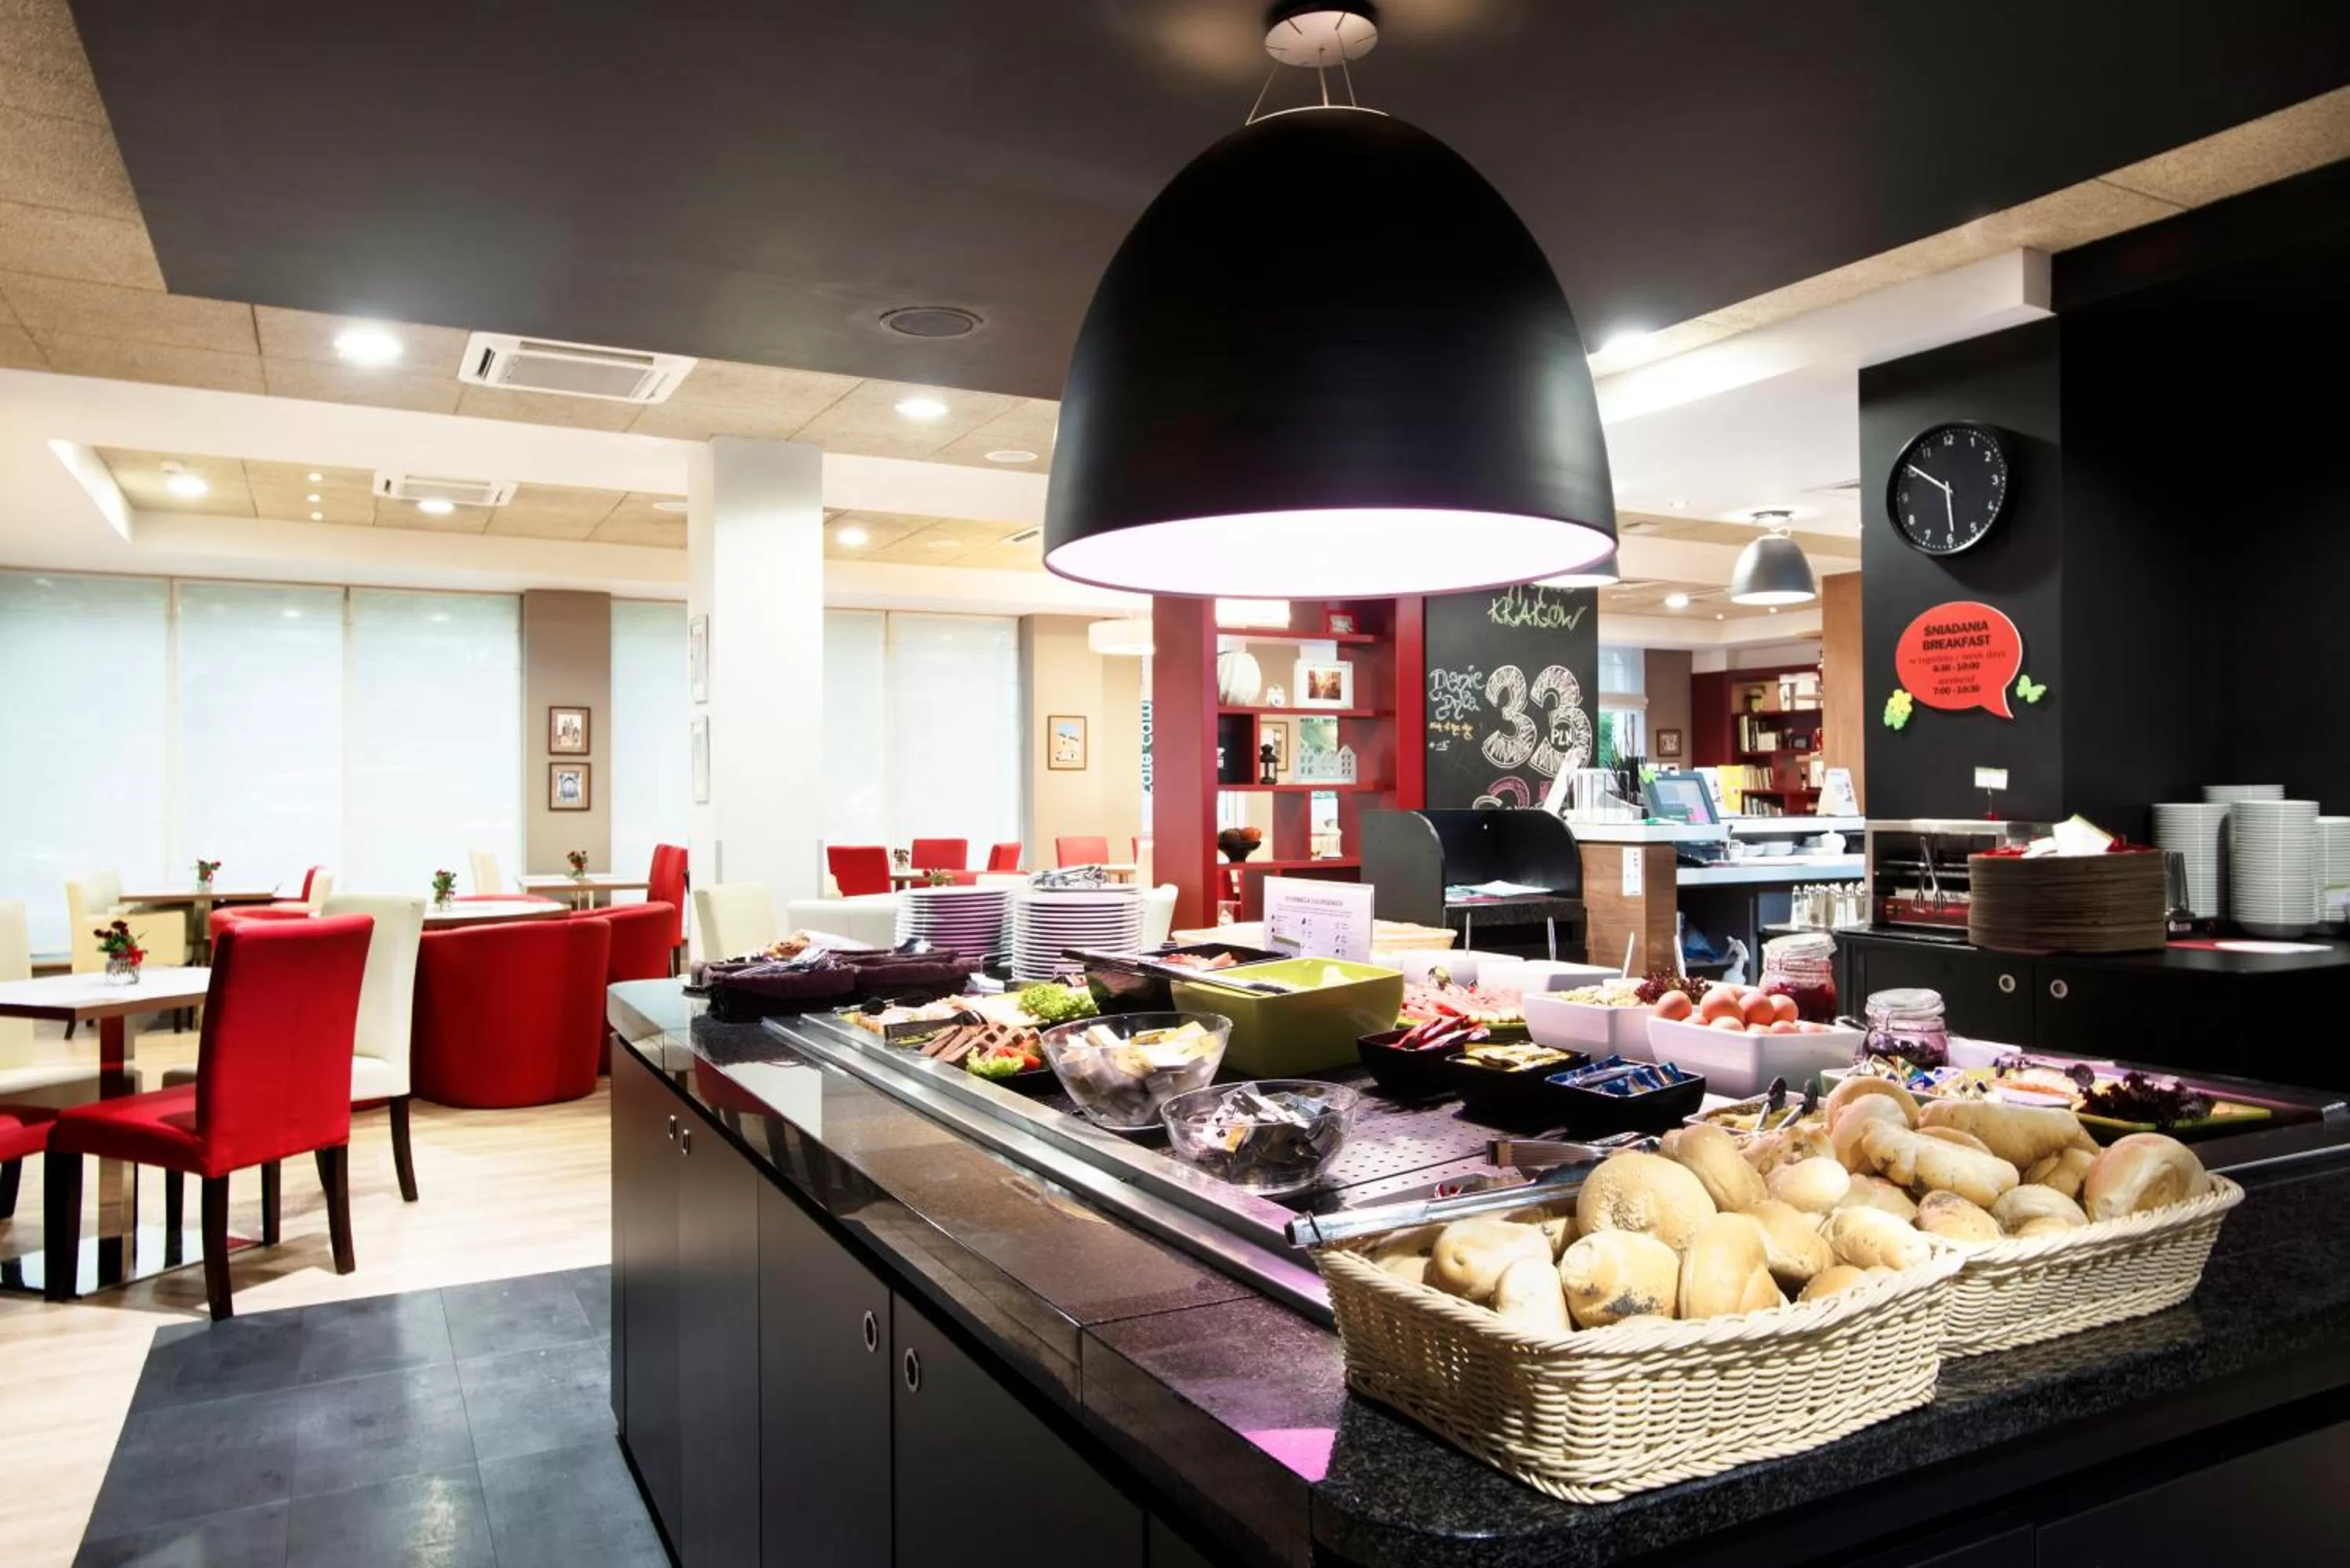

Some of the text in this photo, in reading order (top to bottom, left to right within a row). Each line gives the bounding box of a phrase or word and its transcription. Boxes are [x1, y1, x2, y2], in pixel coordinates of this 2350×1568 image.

[1943, 434, 1954, 446] 12
[1984, 450, 1991, 462] 2
[1992, 474, 1998, 486] 3
[1987, 500, 1994, 510] 4
[1908, 514, 1915, 526] 8
[1970, 522, 1977, 533] 5
[1925, 529, 1932, 540] 7
[1947, 533, 1954, 544] 6
[1923, 620, 1990, 637] ŚNIADANIA
[1922, 634, 1991, 651] BREAKFAST
[1481, 665, 1593, 779] 33
[1551, 728, 1573, 746] PLN
